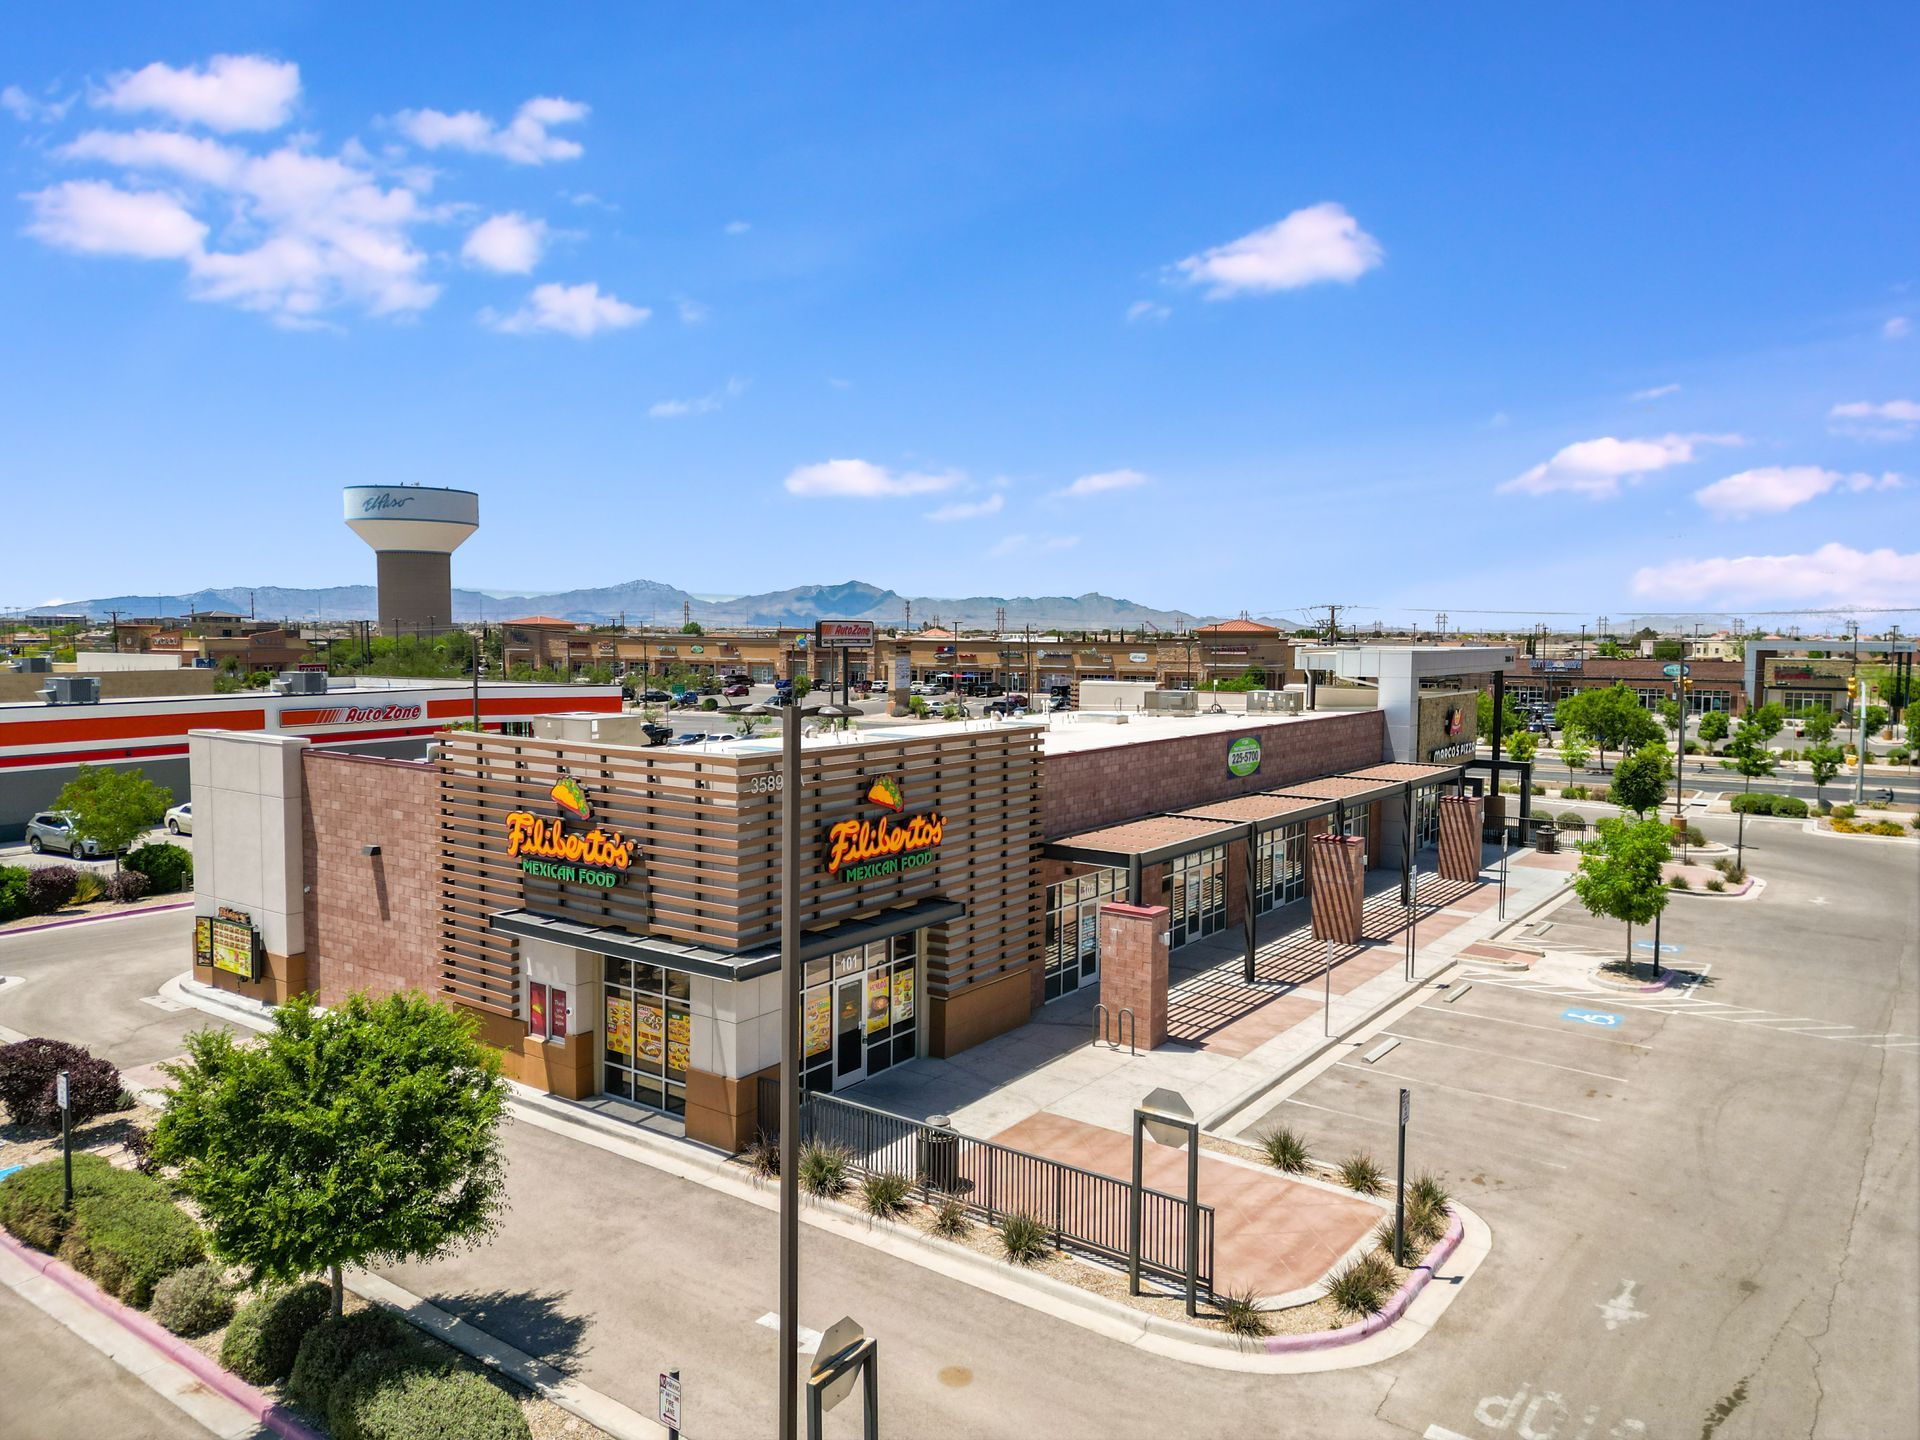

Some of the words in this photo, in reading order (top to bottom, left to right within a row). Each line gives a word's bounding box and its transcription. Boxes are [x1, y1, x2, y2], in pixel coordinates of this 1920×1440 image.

[835, 624, 870, 635] AutoZone
[345, 705, 421, 723] AutoZone
[1232, 751, 1258, 765] 225-5700
[506, 811, 629, 870] Filiberto's
[828, 812, 943, 875] Filiberto's
[522, 860, 576, 882] MEXICAN
[579, 868, 617, 888] FOOD
[846, 859, 898, 883] MEXICAN
[901, 851, 932, 871] FOOD
[841, 954, 857, 972] 101
